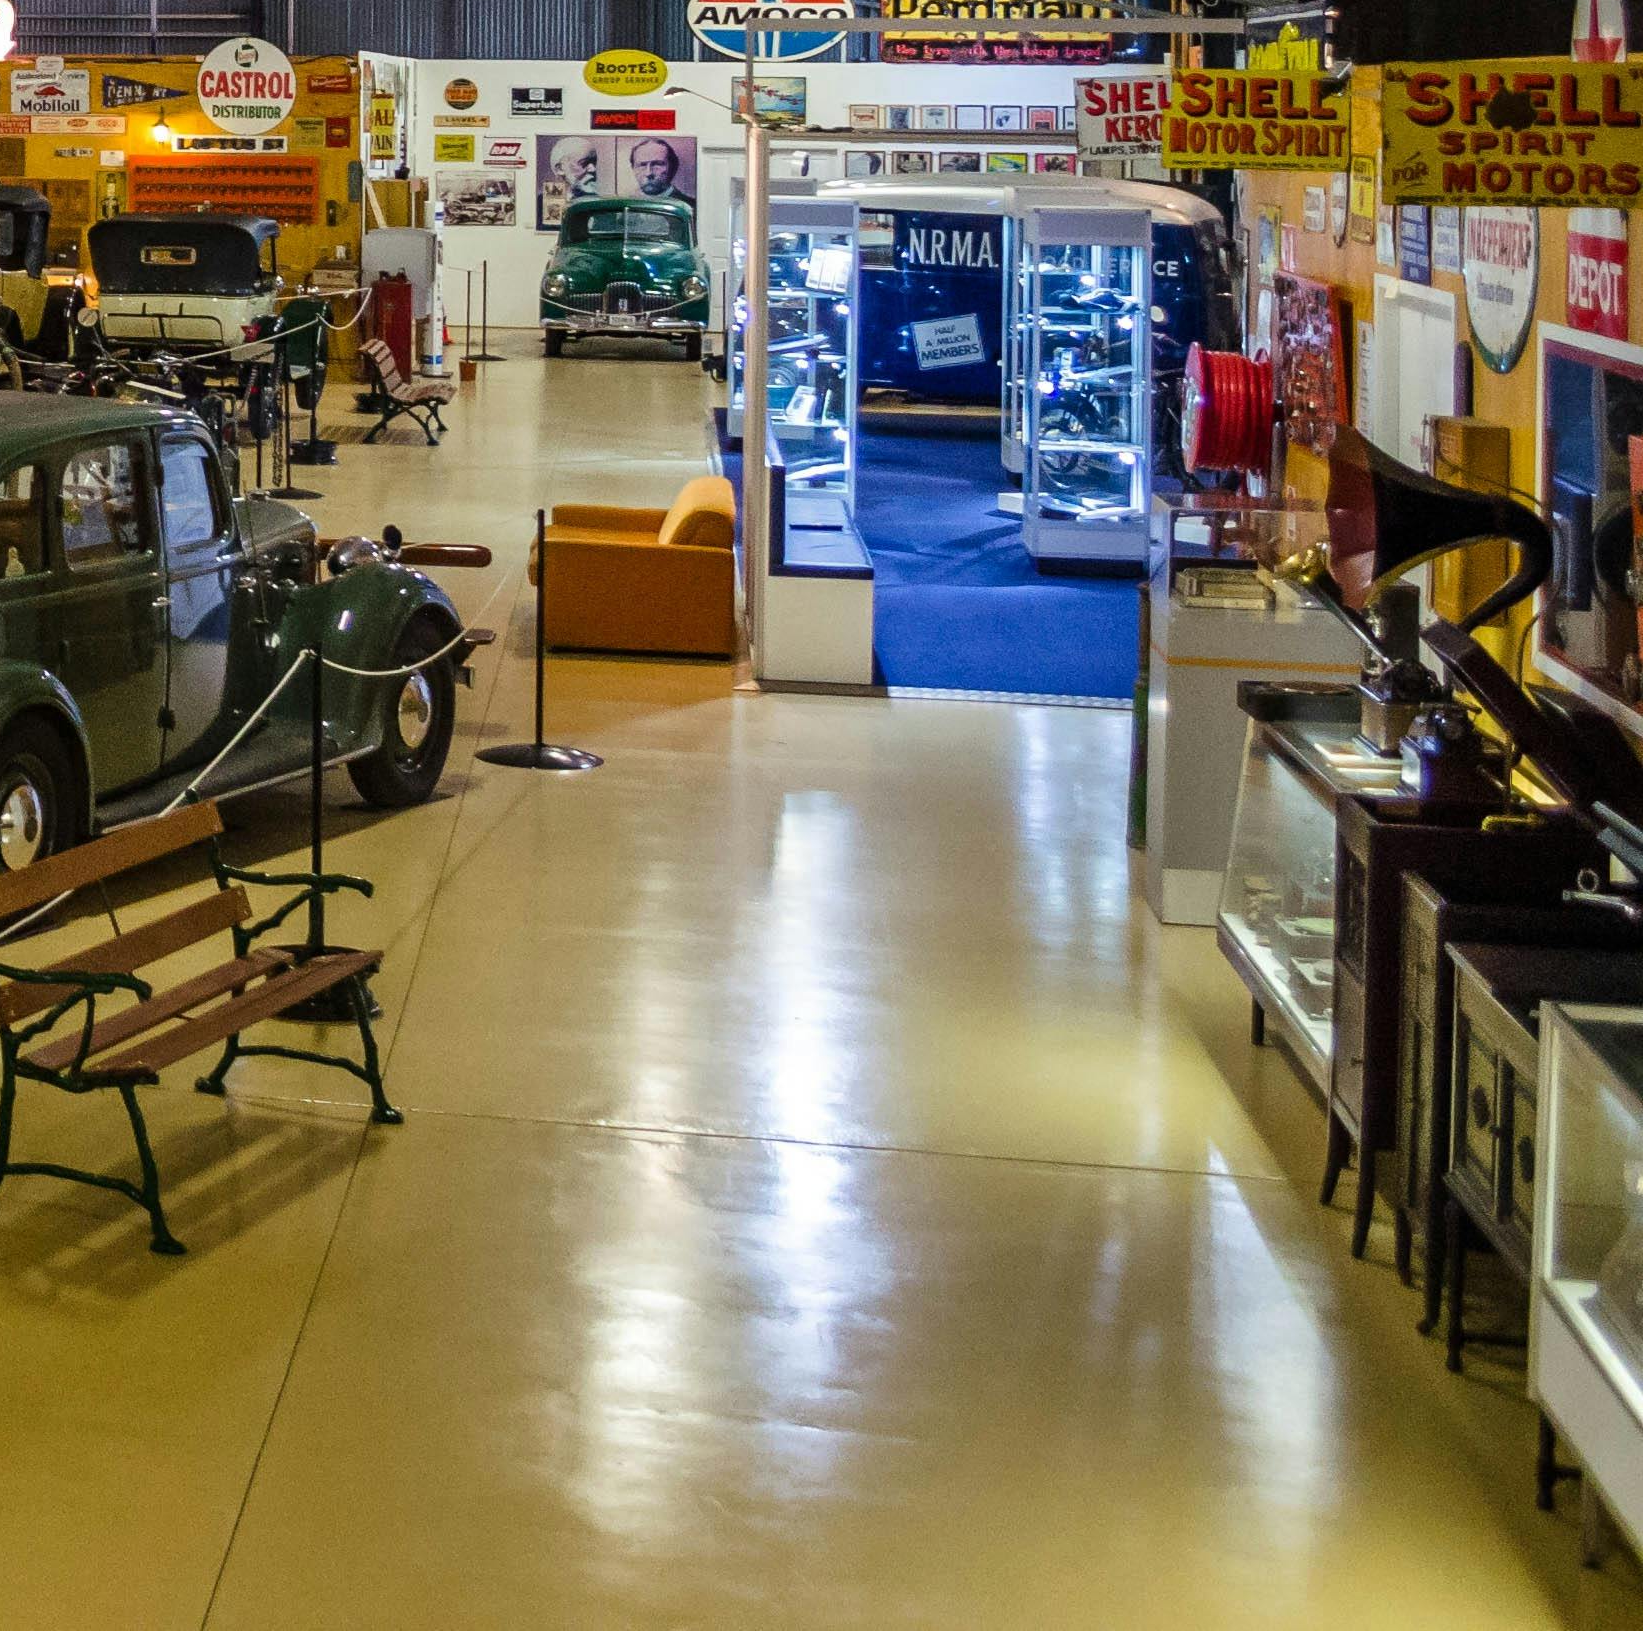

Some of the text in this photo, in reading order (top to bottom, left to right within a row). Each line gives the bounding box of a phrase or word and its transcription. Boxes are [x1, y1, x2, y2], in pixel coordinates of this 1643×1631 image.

[693, 5, 847, 25] AMOCO
[595, 61, 658, 74] ROOTES
[200, 70, 294, 99] CASTROL
[592, 76, 659, 84] GROUP SERVICE
[19, 99, 80, 112] Mobiloil
[212, 104, 282, 118] DISTRIBUTOR
[512, 100, 563, 111] Superlube
[1169, 118, 1347, 157] MOTOR SPIRIT
[1438, 131, 1595, 156] SPIRIT
[1392, 159, 1642, 195] FOR MOTORS
[908, 228, 1000, 267] N.R.M.A.
[1569, 253, 1624, 316] DEPOT
[934, 324, 956, 336] HALF
[936, 334, 971, 346] MILLION
[921, 343, 980, 361] MEMBERS
